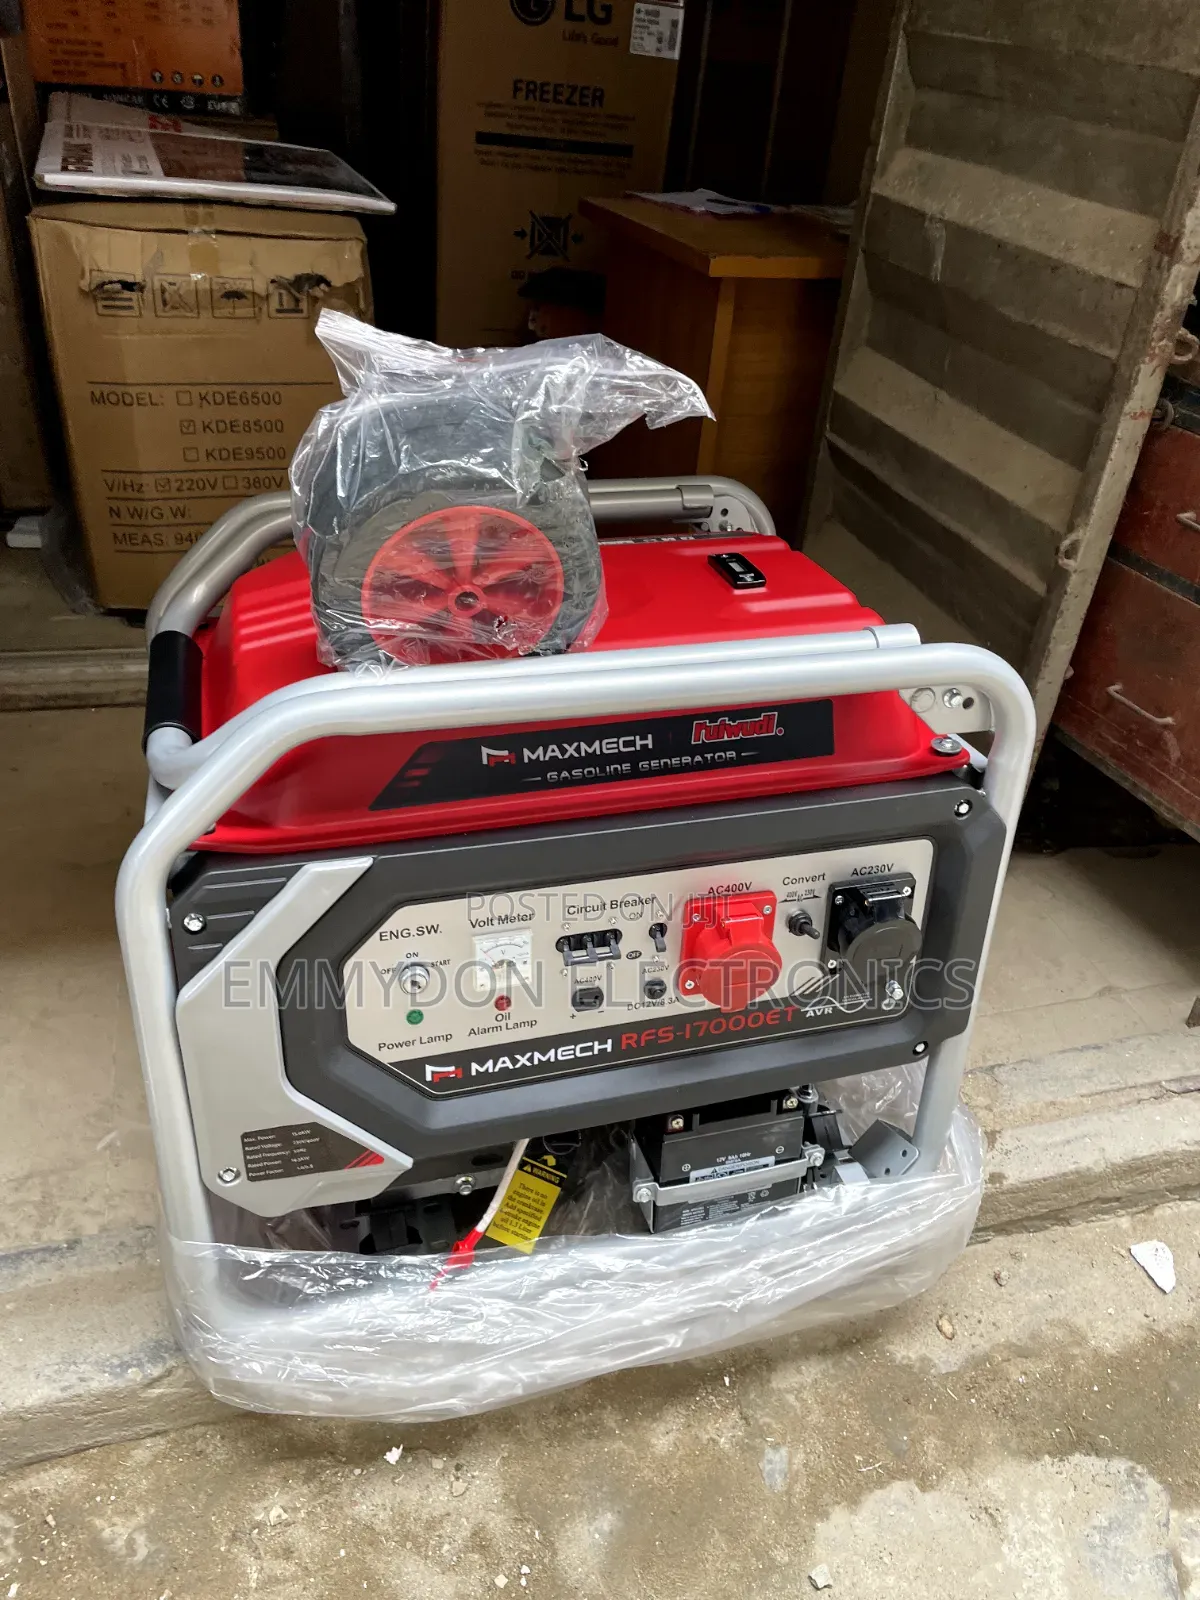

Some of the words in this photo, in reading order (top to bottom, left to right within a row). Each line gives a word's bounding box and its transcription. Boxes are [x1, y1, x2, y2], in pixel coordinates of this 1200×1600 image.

[563, 0, 612, 25] LG
[512, 79, 605, 108] FREEZER
[90, 391, 165, 407] MODEL:
[198, 391, 283, 407] KDE6500
[201, 419, 285, 435] KDE8500
[205, 447, 287, 463] KDE9500
[175, 477, 219, 492] 220V
[522, 733, 654, 764] MAXMECH
[546, 761, 633, 783] GASOLINE
[638, 750, 738, 773] GENERATOR
[851, 863, 895, 877] AC230V
[781, 872, 827, 887] Convert
[707, 881, 753, 896] AC400V
[566, 901, 607, 917] Circuit
[609, 895, 657, 911] Breaker
[469, 915, 495, 929] Volt
[497, 910, 536, 925] Meter
[378, 923, 443, 942] ENG.SW.
[405, 951, 419, 960] ON
[628, 951, 642, 959] OFF
[430, 959, 451, 968] START
[494, 1012, 511, 1023] Oil
[805, 1006, 833, 1018] AVR
[467, 1023, 503, 1037] Alarm
[504, 1017, 538, 1033] Lamp
[377, 1035, 417, 1052] Power
[419, 1031, 453, 1047] Lamp
[470, 1038, 613, 1077] MAXMECH
